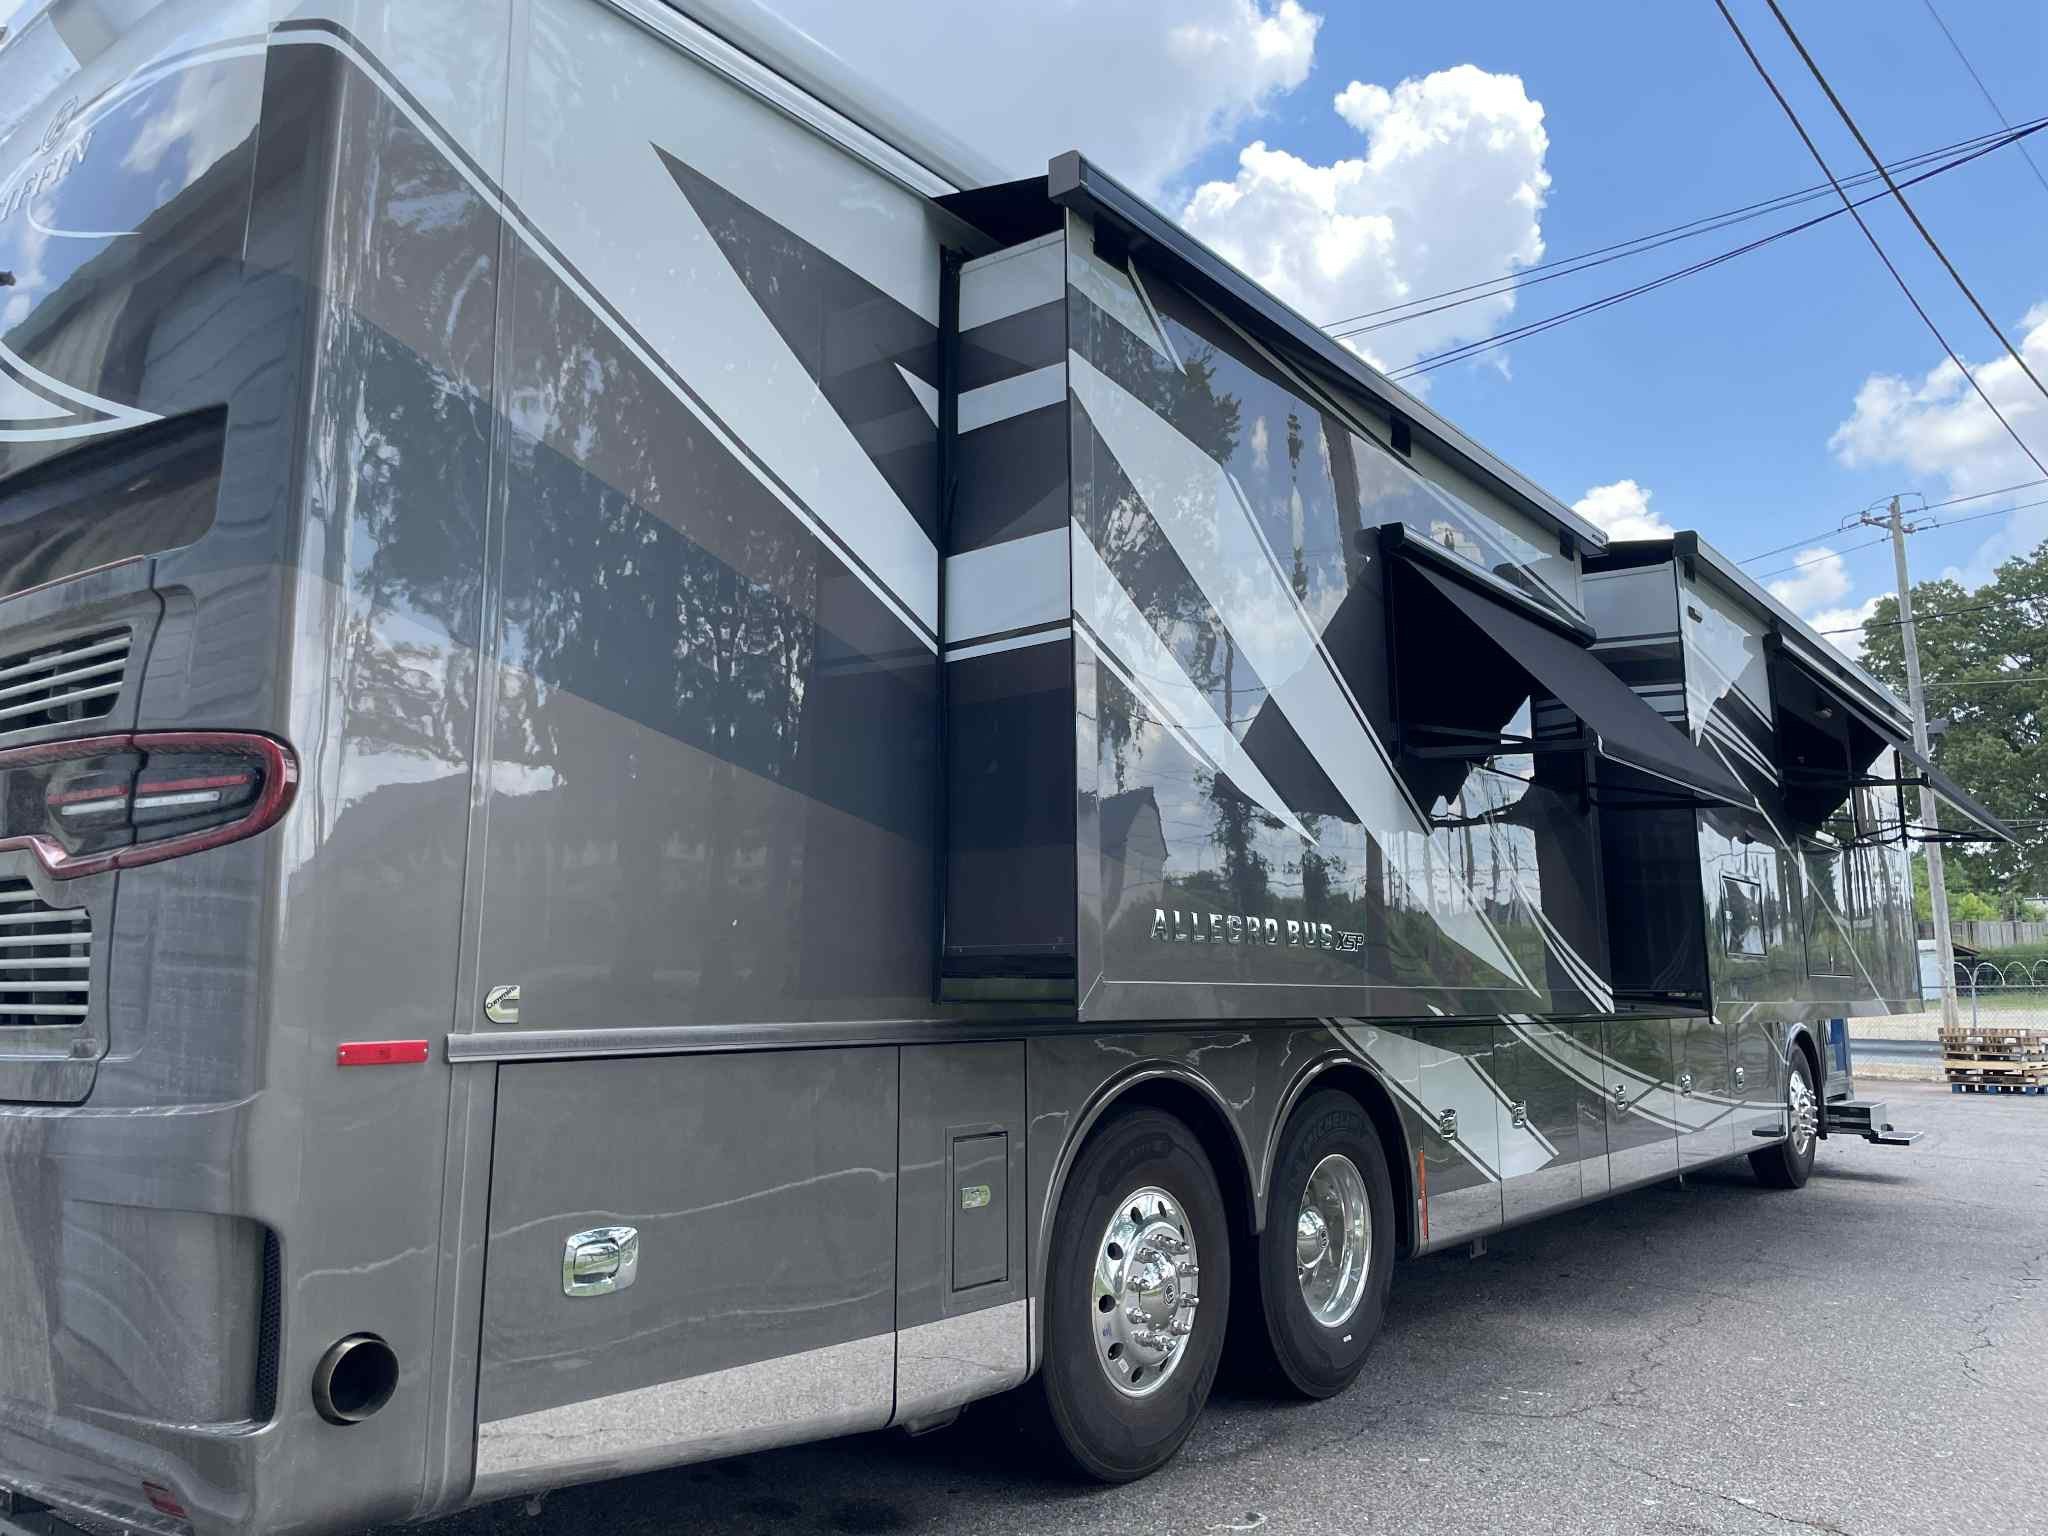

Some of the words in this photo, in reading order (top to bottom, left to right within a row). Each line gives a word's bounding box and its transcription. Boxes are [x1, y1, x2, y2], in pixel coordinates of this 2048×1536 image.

[0, 128, 97, 223] IFFIN
[1150, 908, 1279, 946] ALLEGRO
[1286, 918, 1334, 949] BUS
